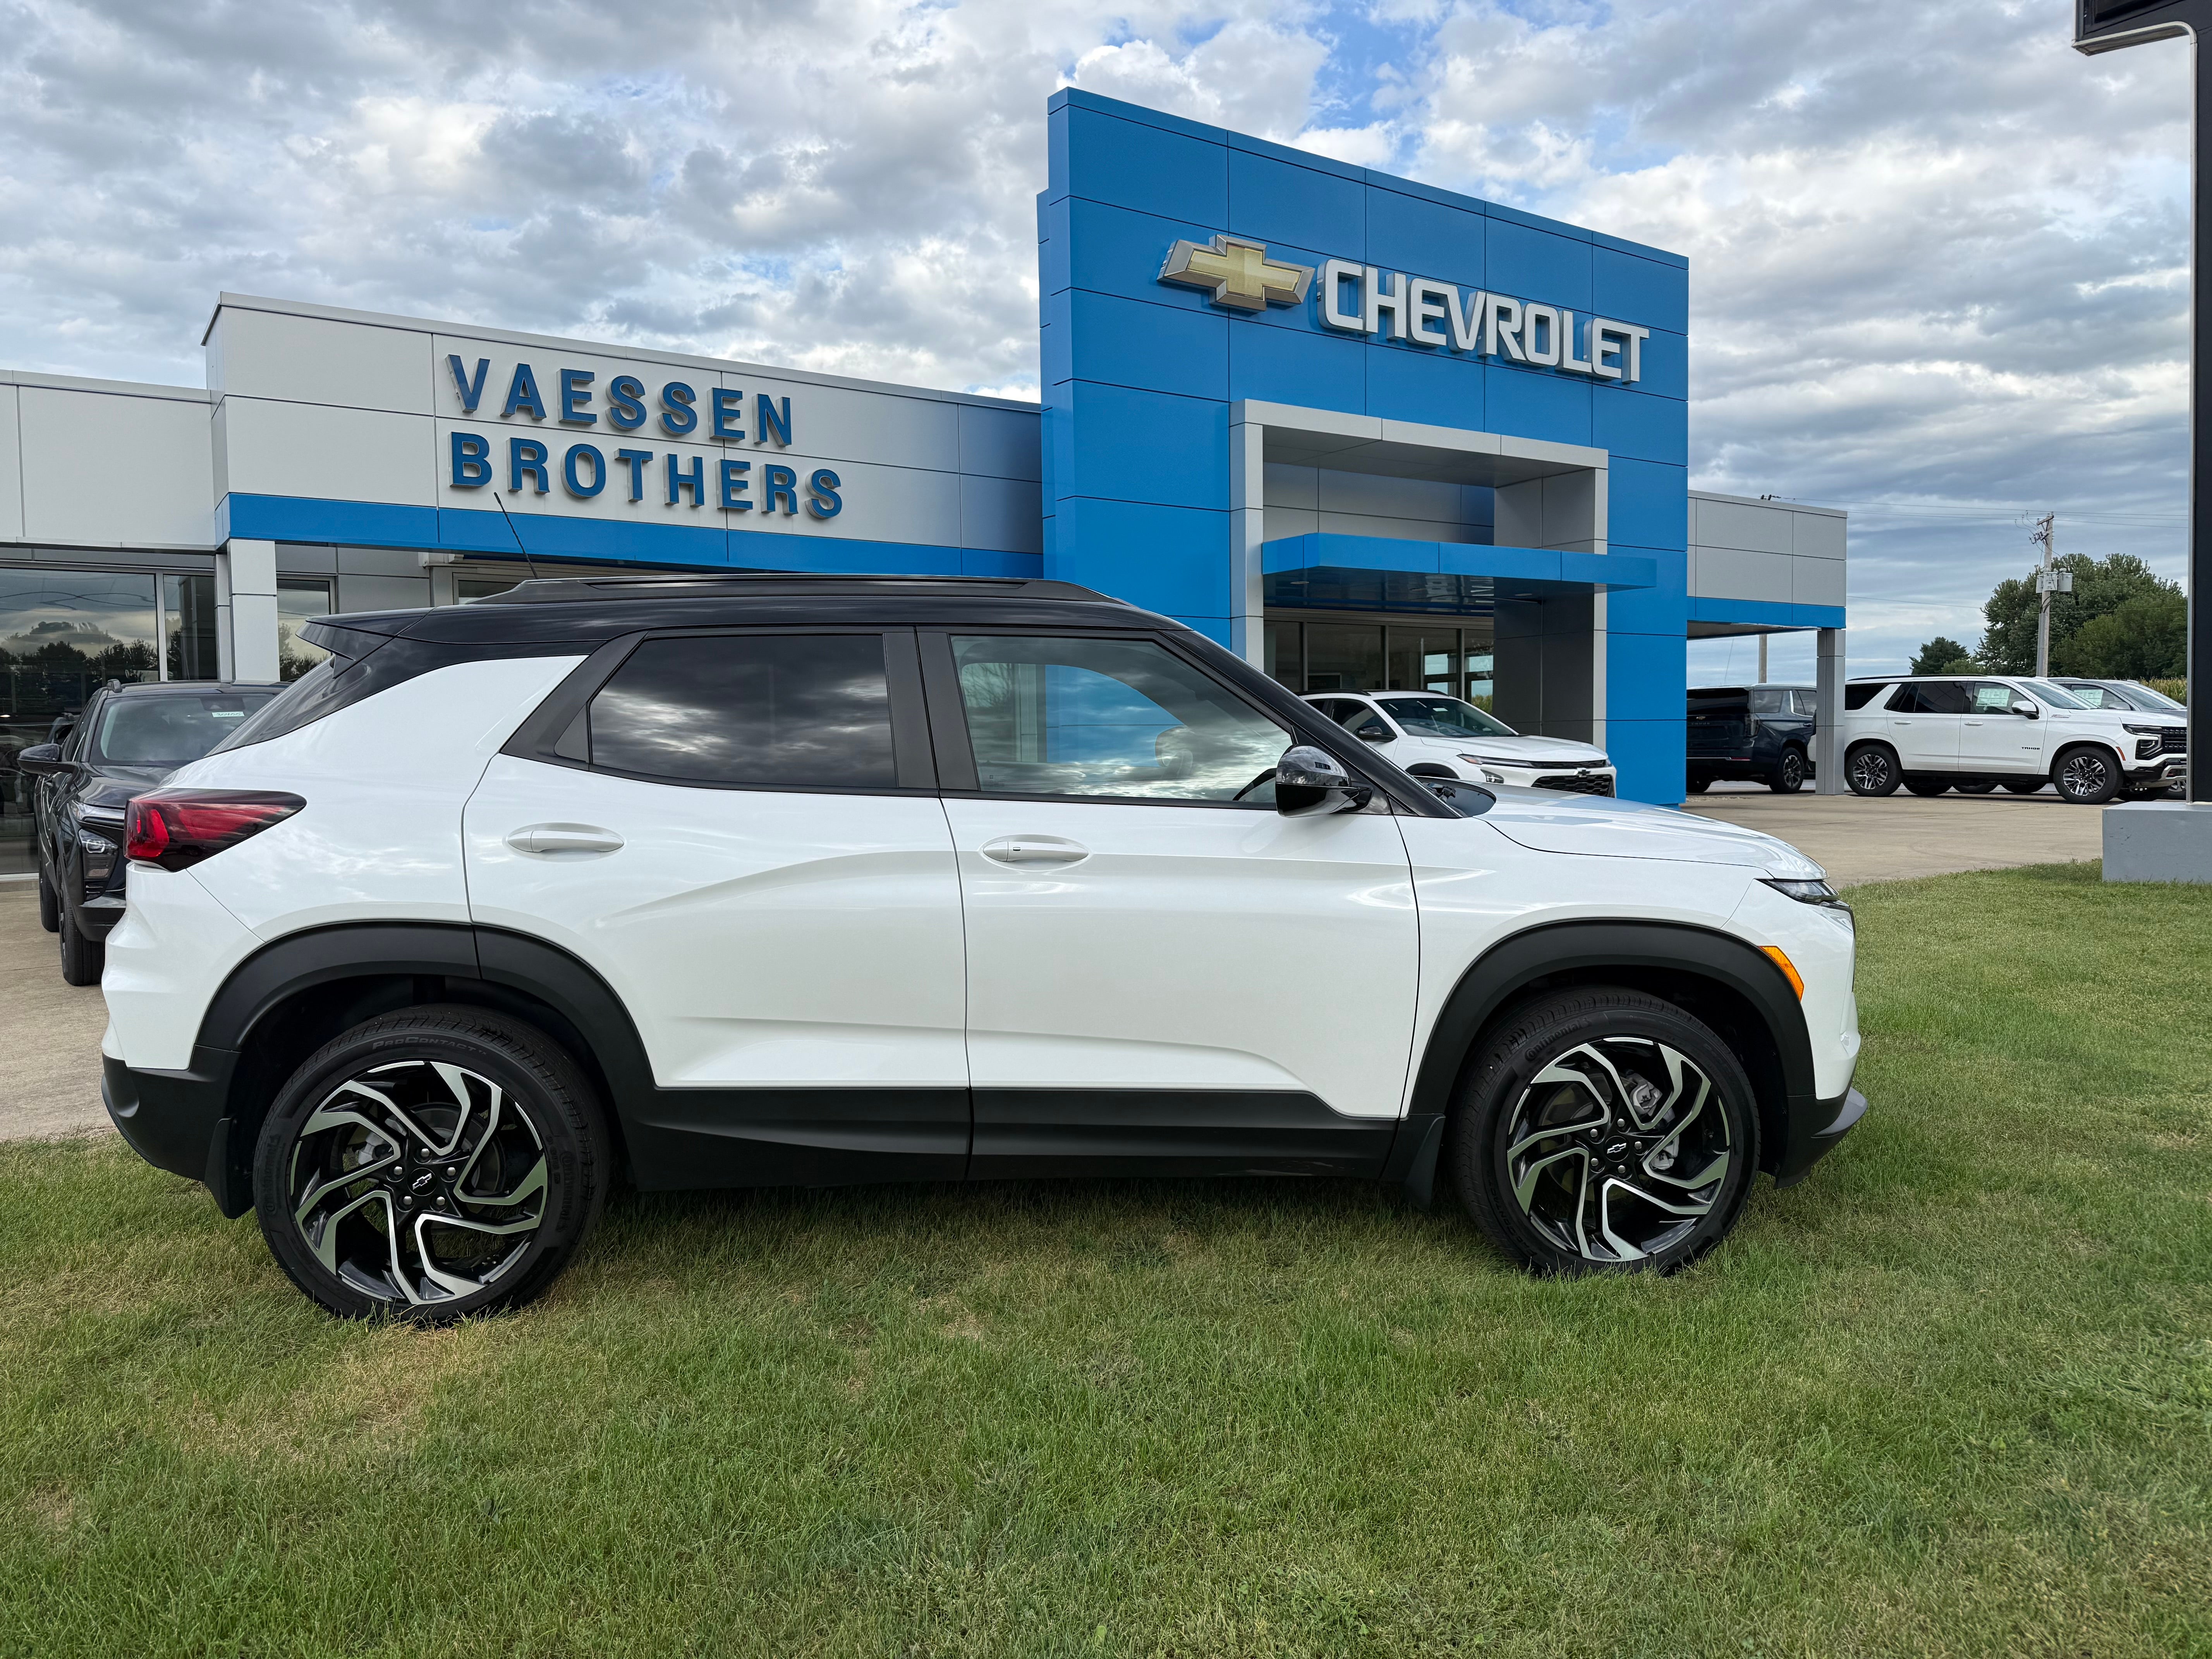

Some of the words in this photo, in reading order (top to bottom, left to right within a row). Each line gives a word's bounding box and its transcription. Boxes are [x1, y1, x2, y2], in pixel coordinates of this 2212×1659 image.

[1317, 258, 1649, 383] CHEVROLET
[445, 354, 792, 447] VAESSEN
[448, 431, 842, 519] BROTHERS
[1525, 1020, 1583, 1061] Continental
